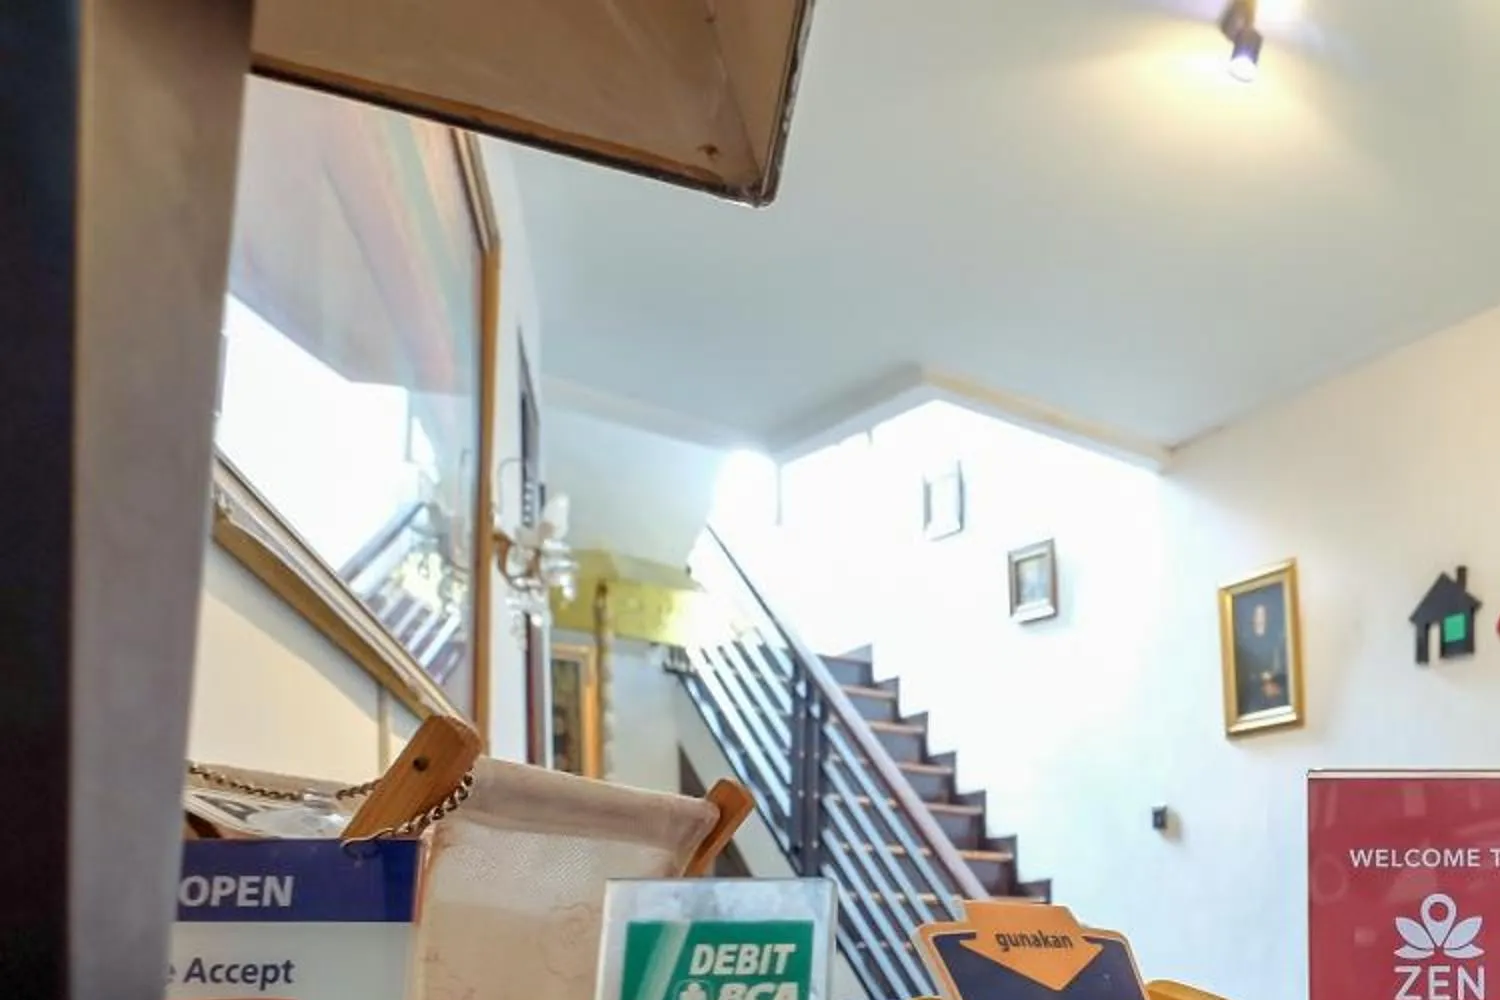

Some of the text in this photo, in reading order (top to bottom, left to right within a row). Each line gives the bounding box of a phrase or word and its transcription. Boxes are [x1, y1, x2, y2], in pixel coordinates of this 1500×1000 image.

[1349, 848, 1480, 868] WELCOME
[178, 875, 295, 908] OPEN
[994, 931, 1072, 952] gunakan
[183, 957, 295, 992] Accept
[688, 943, 797, 976] DEBIT
